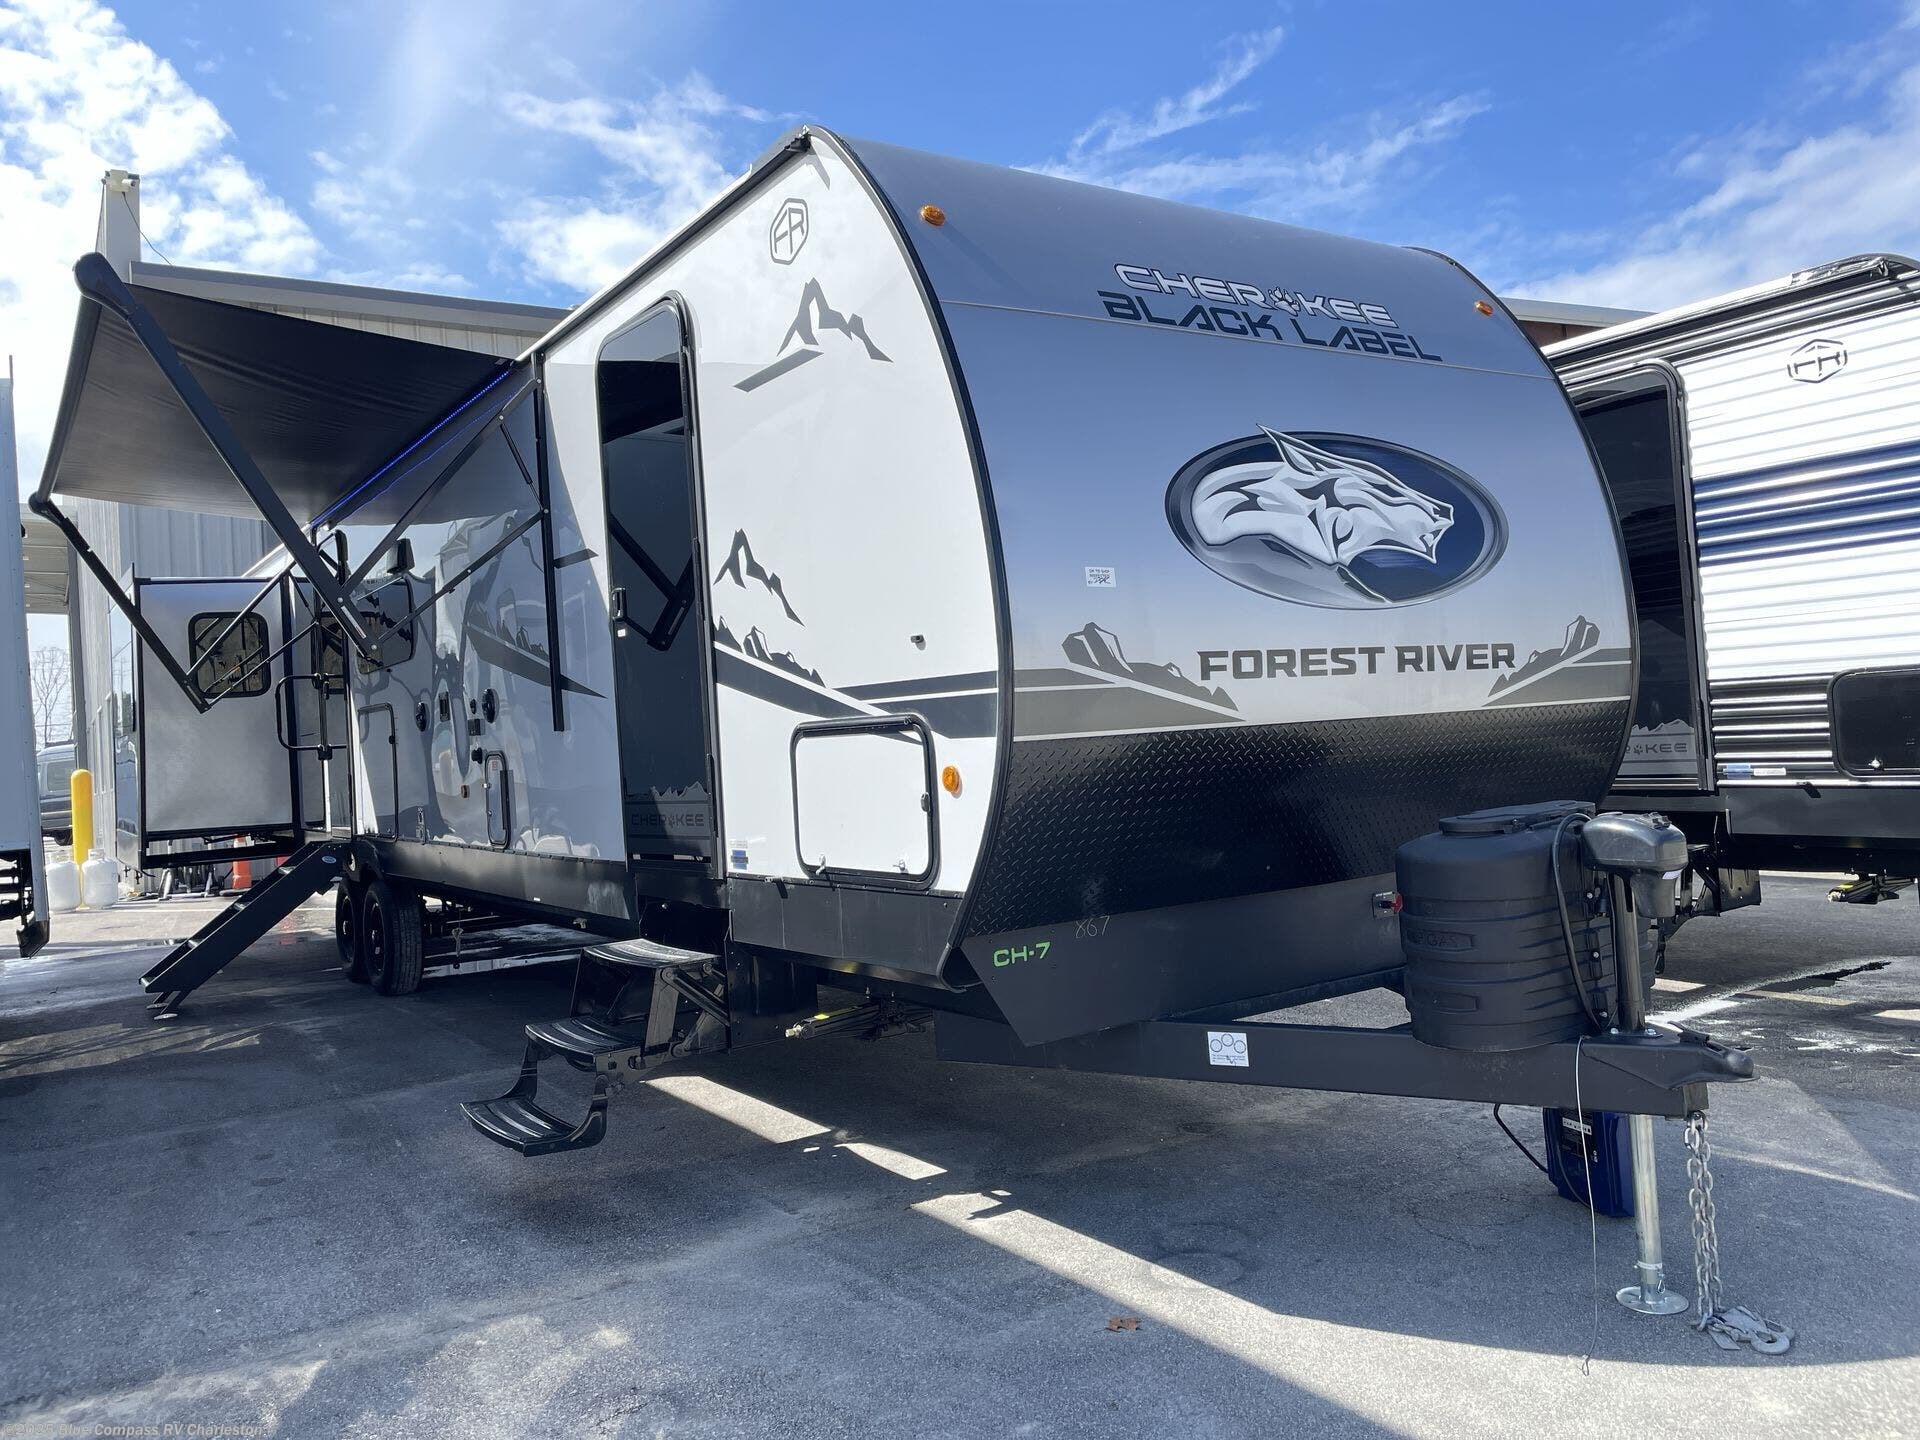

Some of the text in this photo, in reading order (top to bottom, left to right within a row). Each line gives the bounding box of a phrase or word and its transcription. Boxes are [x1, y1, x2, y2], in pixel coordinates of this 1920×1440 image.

[1097, 290, 1443, 361] BLACK LABEL
[1114, 263, 1399, 328] CHEROKEE
[1197, 642, 1517, 681] FOREST RIVER
